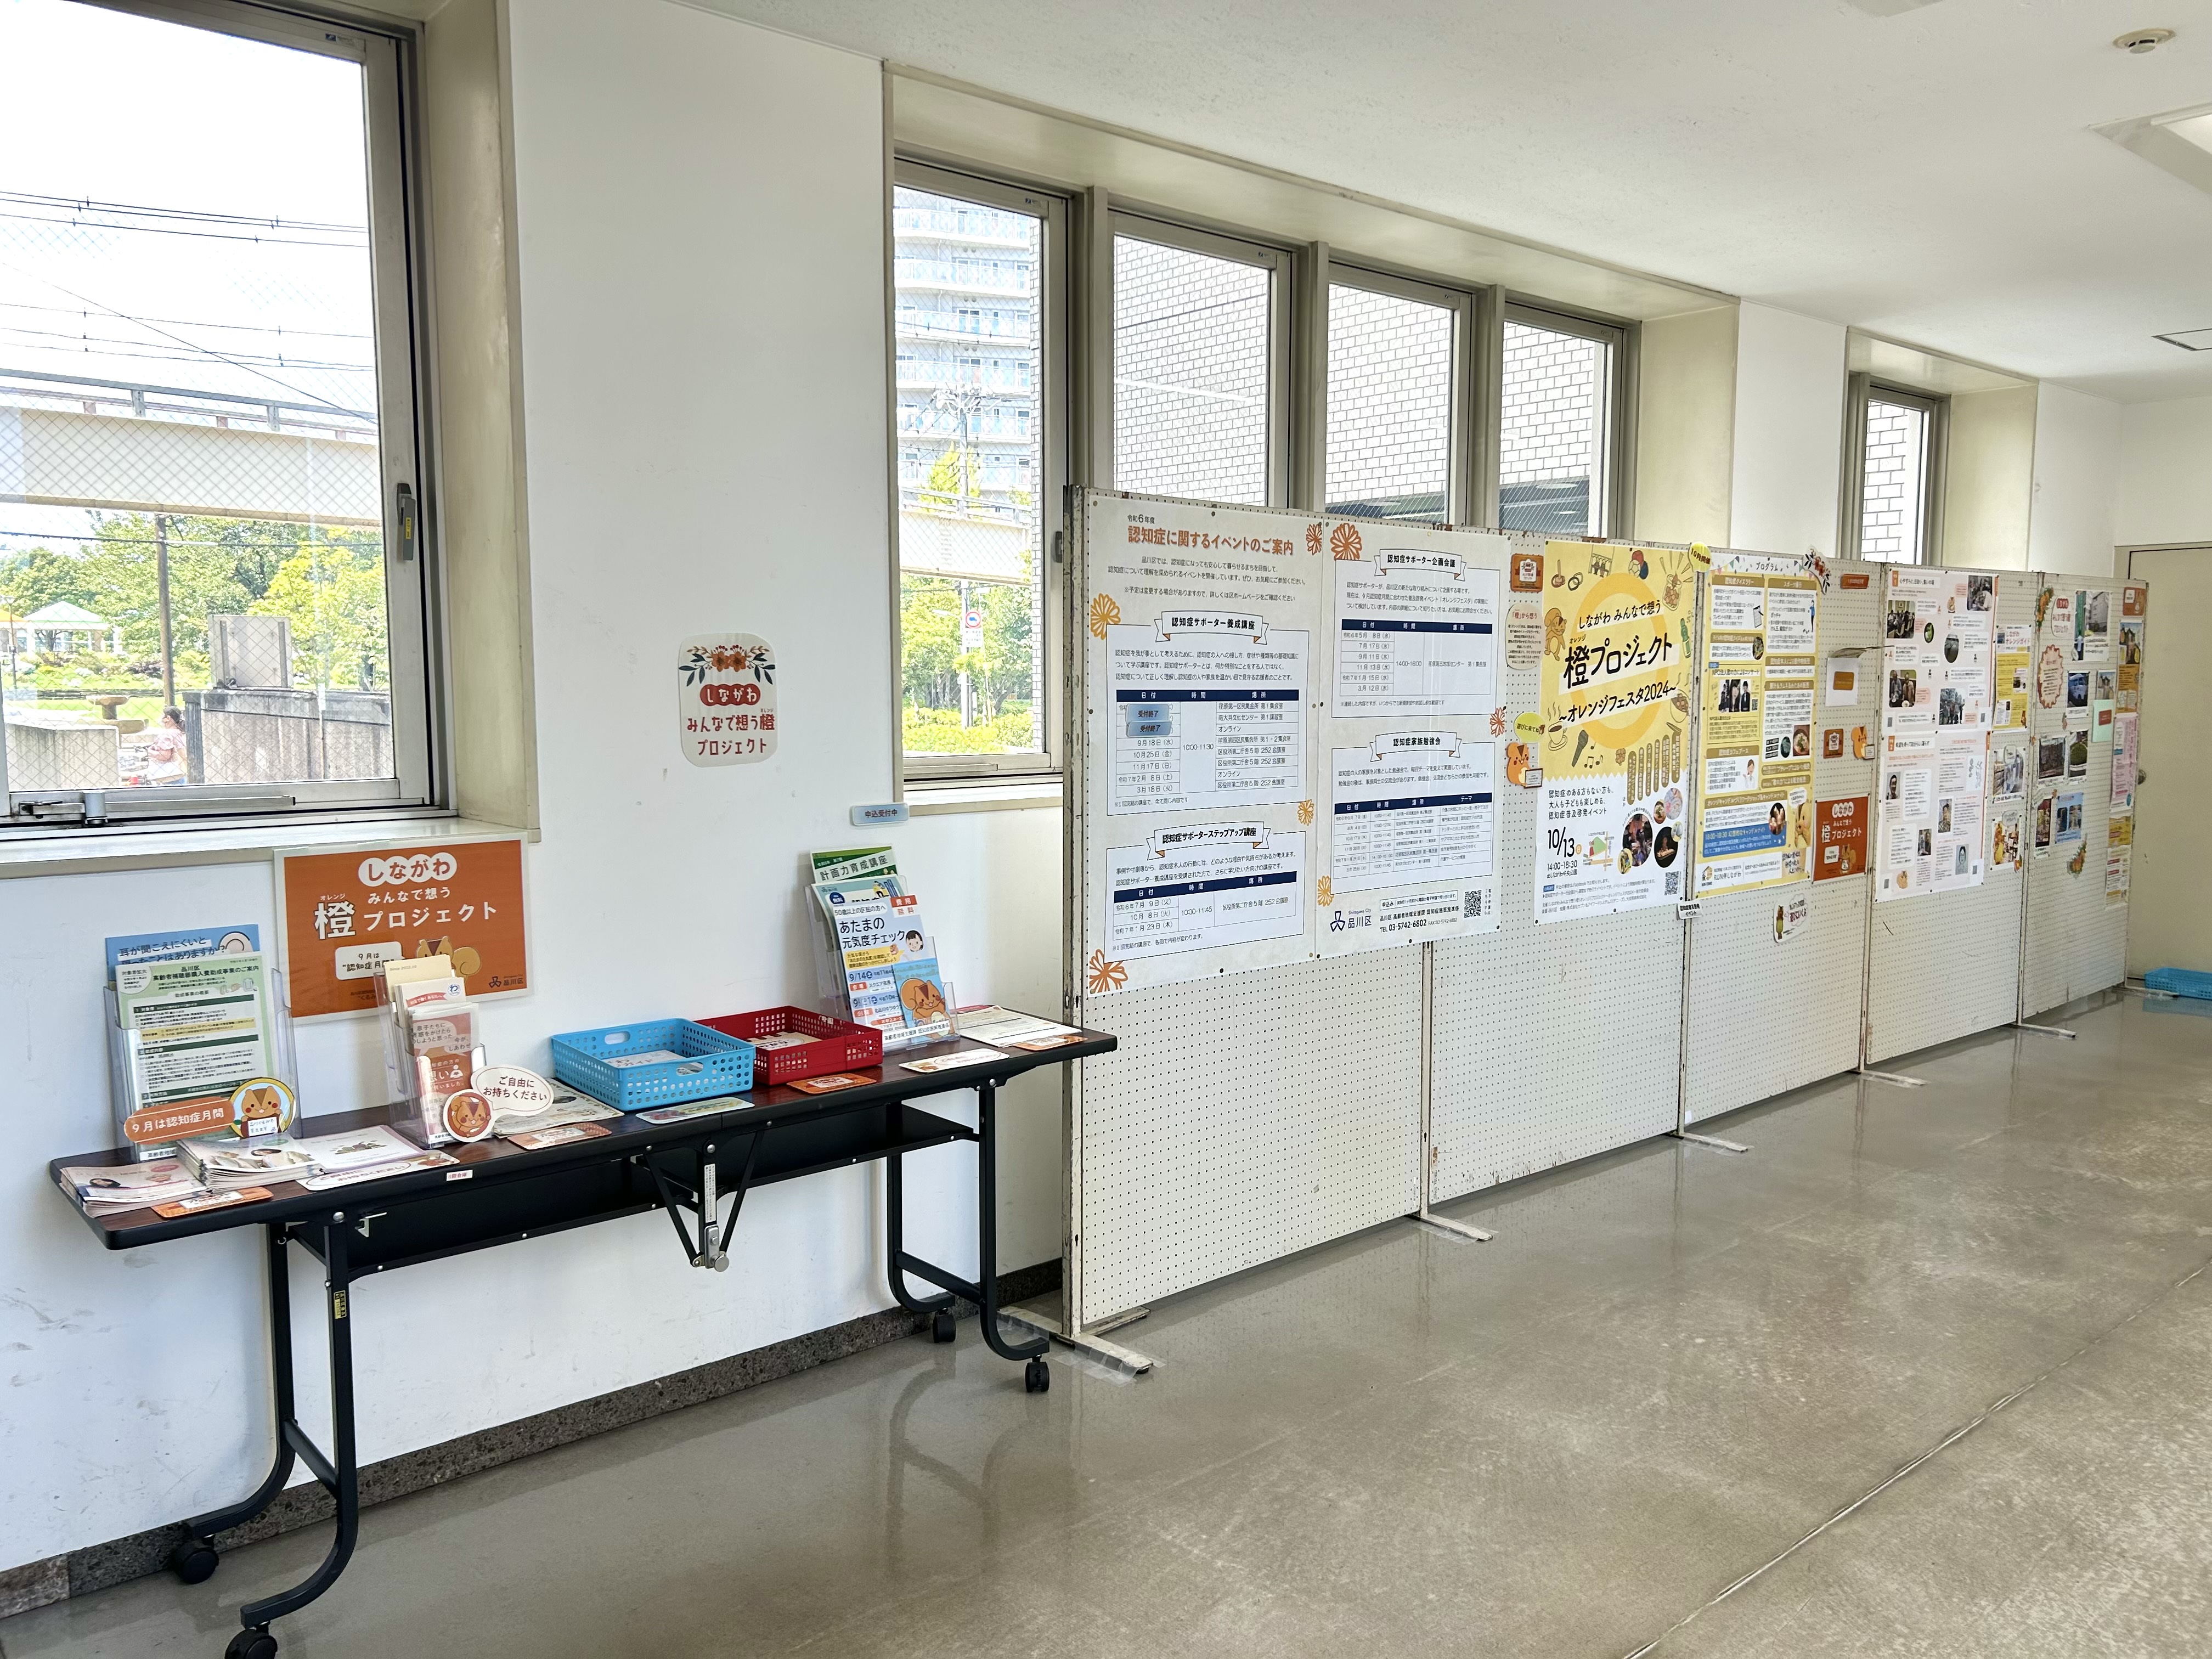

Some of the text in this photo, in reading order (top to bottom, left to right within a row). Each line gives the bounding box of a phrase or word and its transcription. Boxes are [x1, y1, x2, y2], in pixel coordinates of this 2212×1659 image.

[1127, 514, 1155, 524] 令和6年度
[1128, 525, 1293, 556] 認知症に関するイベントのご案内
[1387, 554, 1455, 567] 認知症サポーター企画会議
[1756, 561, 1779, 572] プログラム
[1578, 600, 1661, 630] しながわ みんなで想う
[1171, 617, 1255, 630] 認知症サポーター養成講座
[1570, 634, 1586, 644] オレンジ
[1564, 632, 1672, 689] 橙プロジェクト
[707, 687, 757, 703] しながわ
[1138, 710, 1159, 718] 受付終了
[687, 714, 775, 732] みんなで想う橙
[698, 738, 766, 755] プロジェクト
[1393, 737, 1441, 747] 認知症家族勉強会
[1549, 786, 1613, 798] 認知症のある方もない方も、
[1549, 797, 1606, 809] 大人も子どもも楽しめる、
[1834, 803, 1853, 815] しながわ
[865, 809, 898, 819] 申込受付中
[1549, 808, 1607, 820] 認知症普及啓発イベント
[1163, 827, 1256, 844] 認知症サポーターステップアップ講座
[1832, 827, 1861, 840] プロジェクト
[1548, 826, 1575, 858] 10/13
[368, 857, 451, 881] しながわ
[820, 855, 888, 881] 計画力育成講座
[368, 887, 451, 905] みんなで想う
[834, 905, 887, 916] 50歳以上の区民の方へ
[898, 906, 914, 915] 無料
[314, 900, 496, 940] 橙 プロジェクト
[839, 917, 884, 933] あたまの
[1348, 916, 1372, 929] 品川区
[1389, 919, 1426, 932] 03-5742-6802
[120, 936, 206, 956] 耳が聞こえにくいと
[842, 930, 906, 949] 元気度チェック
[849, 972, 866, 981] 9/14
[417, 1023, 445, 1031] 息子たちに
[449, 1043, 471, 1052] しあわせ
[499, 1076, 535, 1088] ご自由に
[483, 1087, 548, 1101] お持ちください
[132, 1109, 224, 1133] 9月は認知症月間
